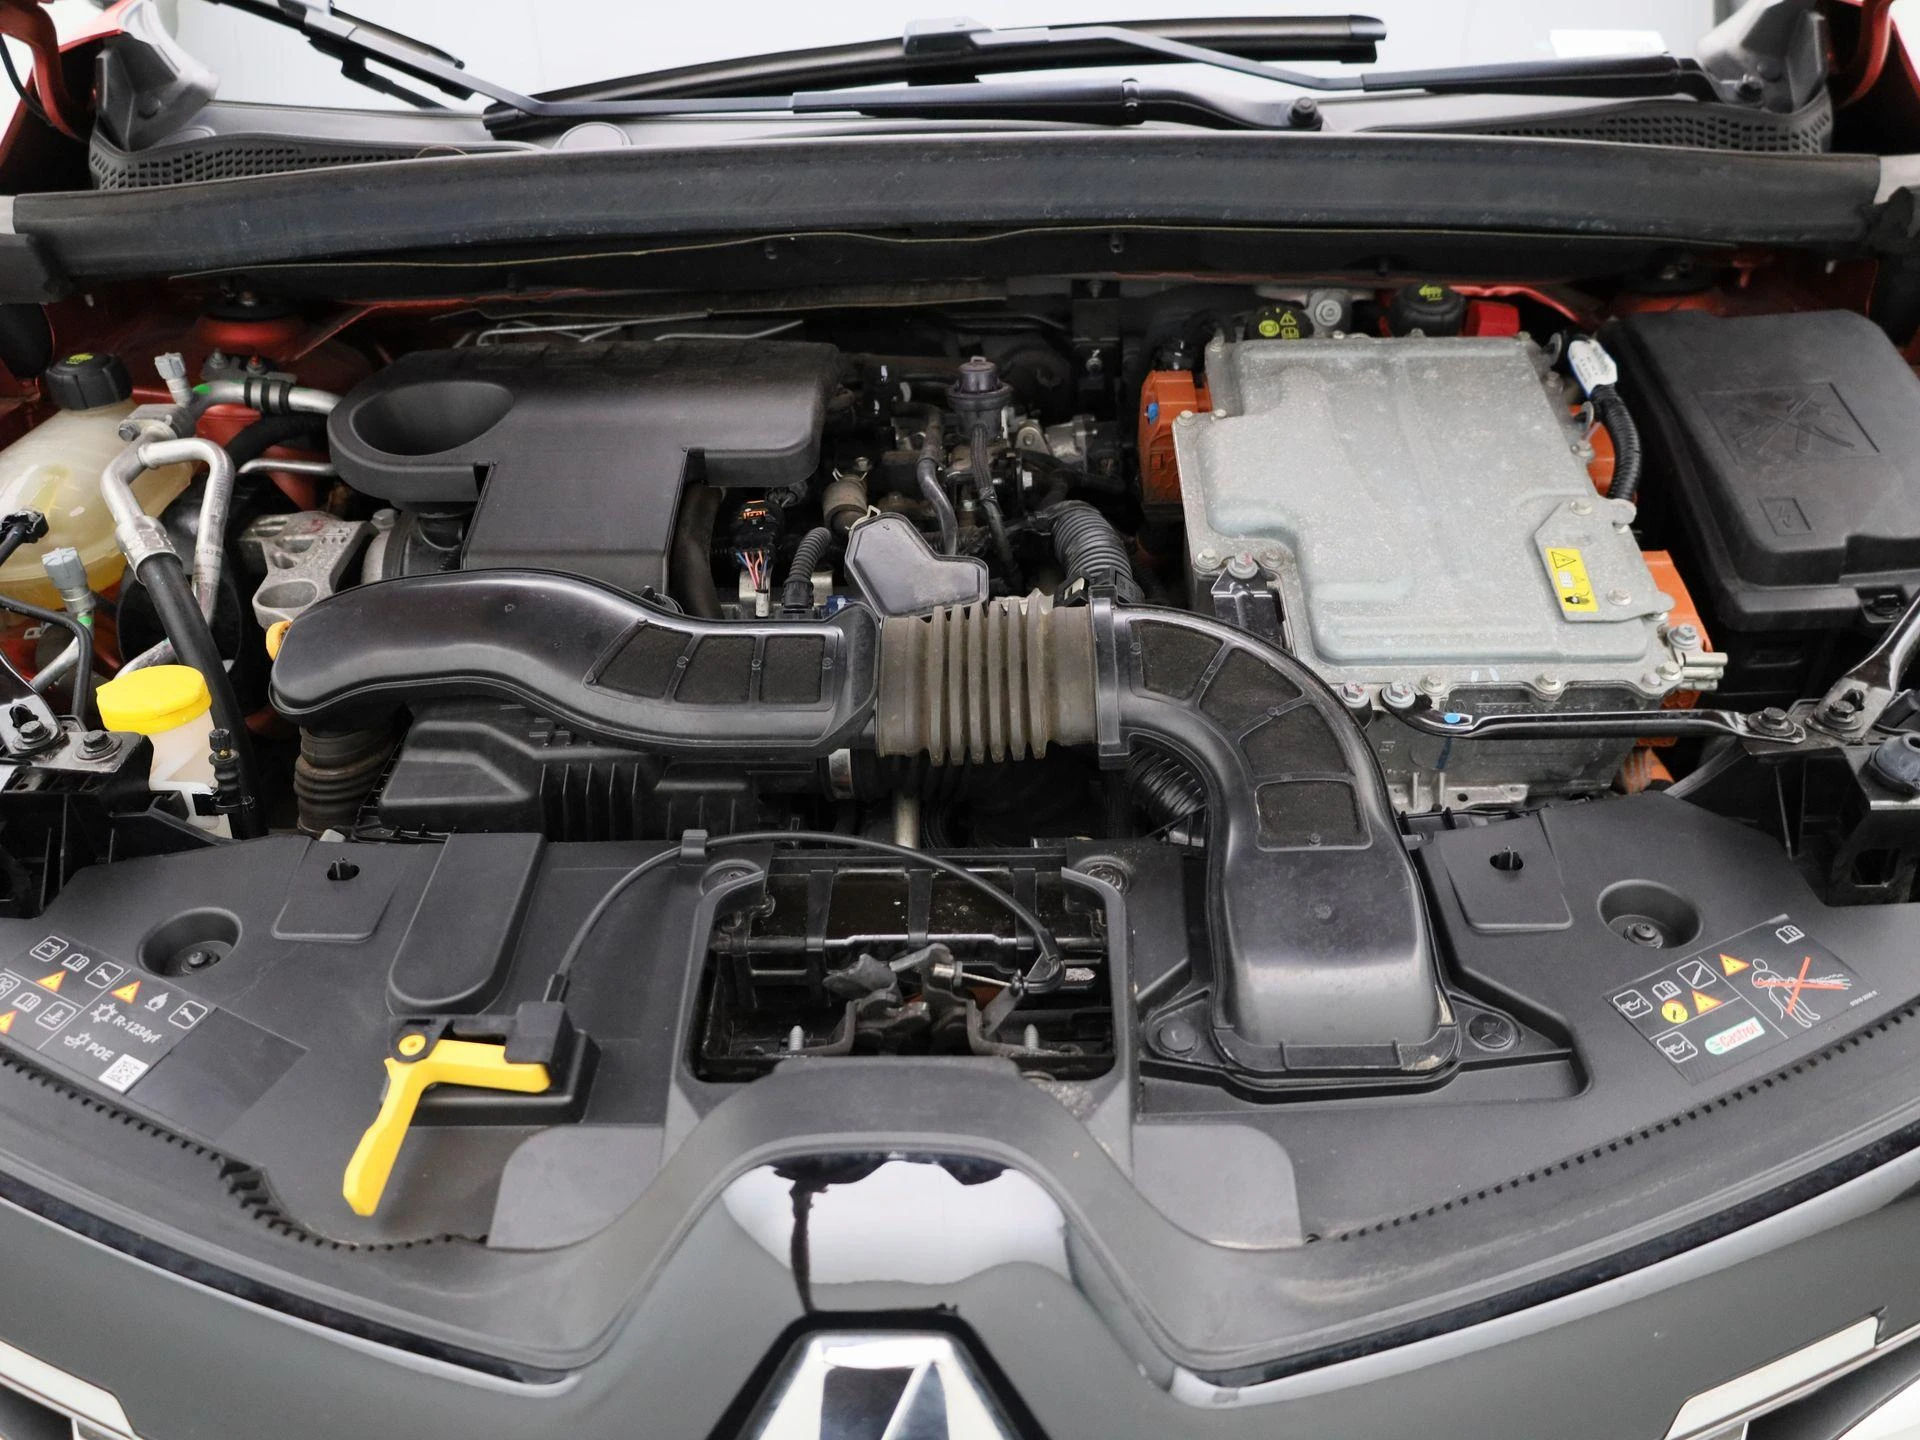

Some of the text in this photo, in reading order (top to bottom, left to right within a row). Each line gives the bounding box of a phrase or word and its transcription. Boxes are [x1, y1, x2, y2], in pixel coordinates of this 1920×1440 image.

[112, 1015, 162, 1044] R-1234yf
[1719, 1022, 1759, 1048] Castrol
[85, 1042, 115, 1061] POE
